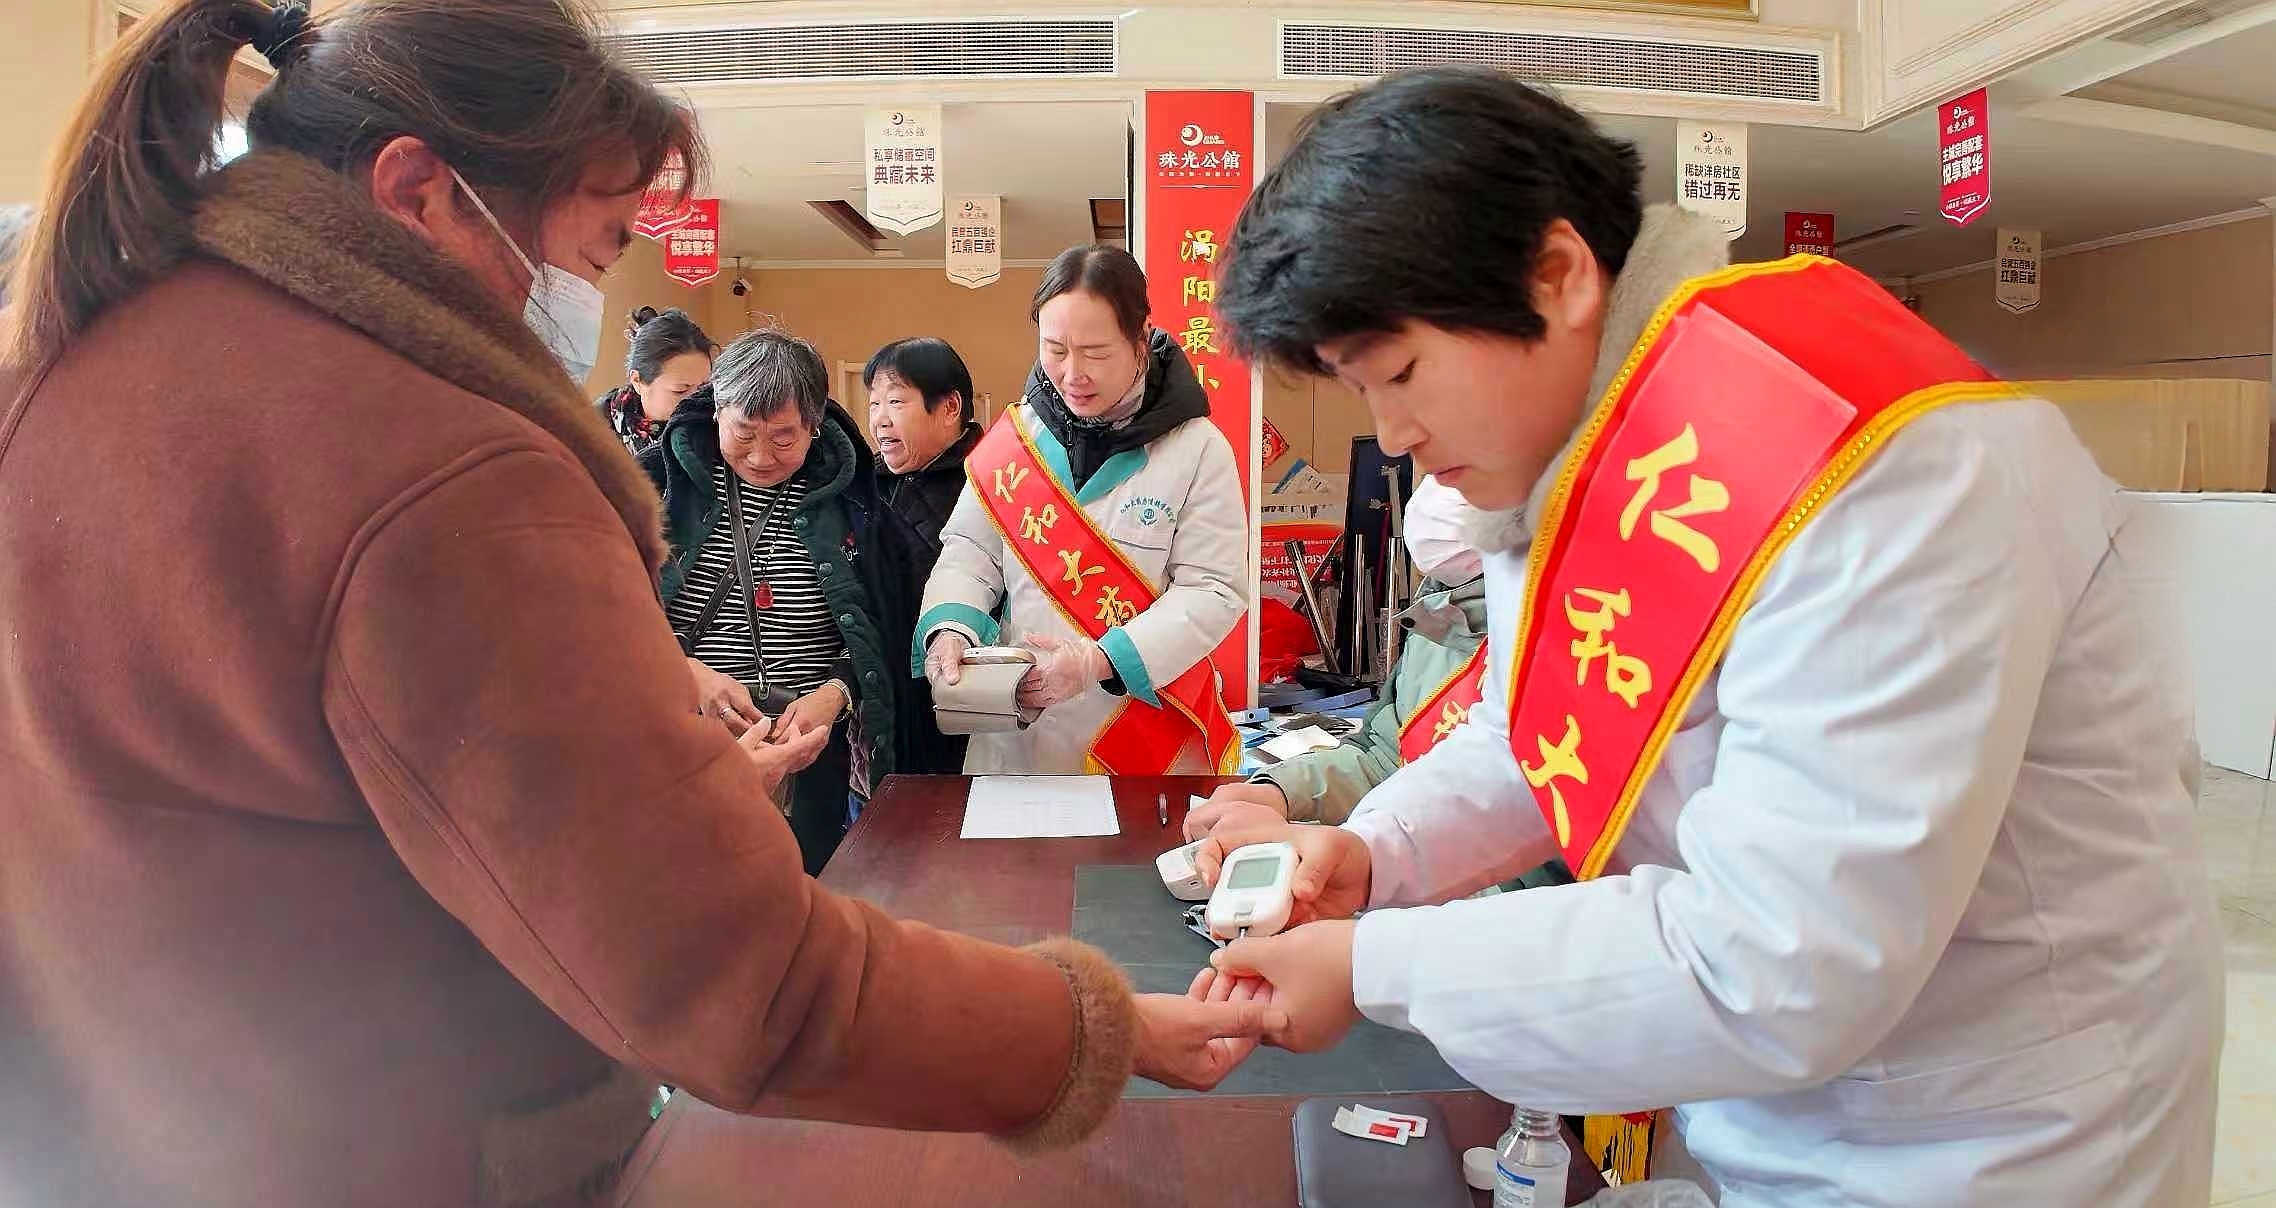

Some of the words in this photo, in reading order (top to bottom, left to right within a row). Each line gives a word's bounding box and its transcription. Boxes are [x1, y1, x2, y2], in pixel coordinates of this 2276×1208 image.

[873, 147, 935, 162] 私享储藏空间
[1159, 149, 1241, 169] 珠光公館
[873, 164, 935, 185] 典藏未来
[1684, 163, 1741, 179] 稀缺洋房社区
[1942, 153, 1984, 186] 悦享繁华
[1684, 180, 1741, 201] 错过再无
[951, 239, 996, 257] 扛鼎巨献
[1520, 421, 1730, 849] 仁和大
